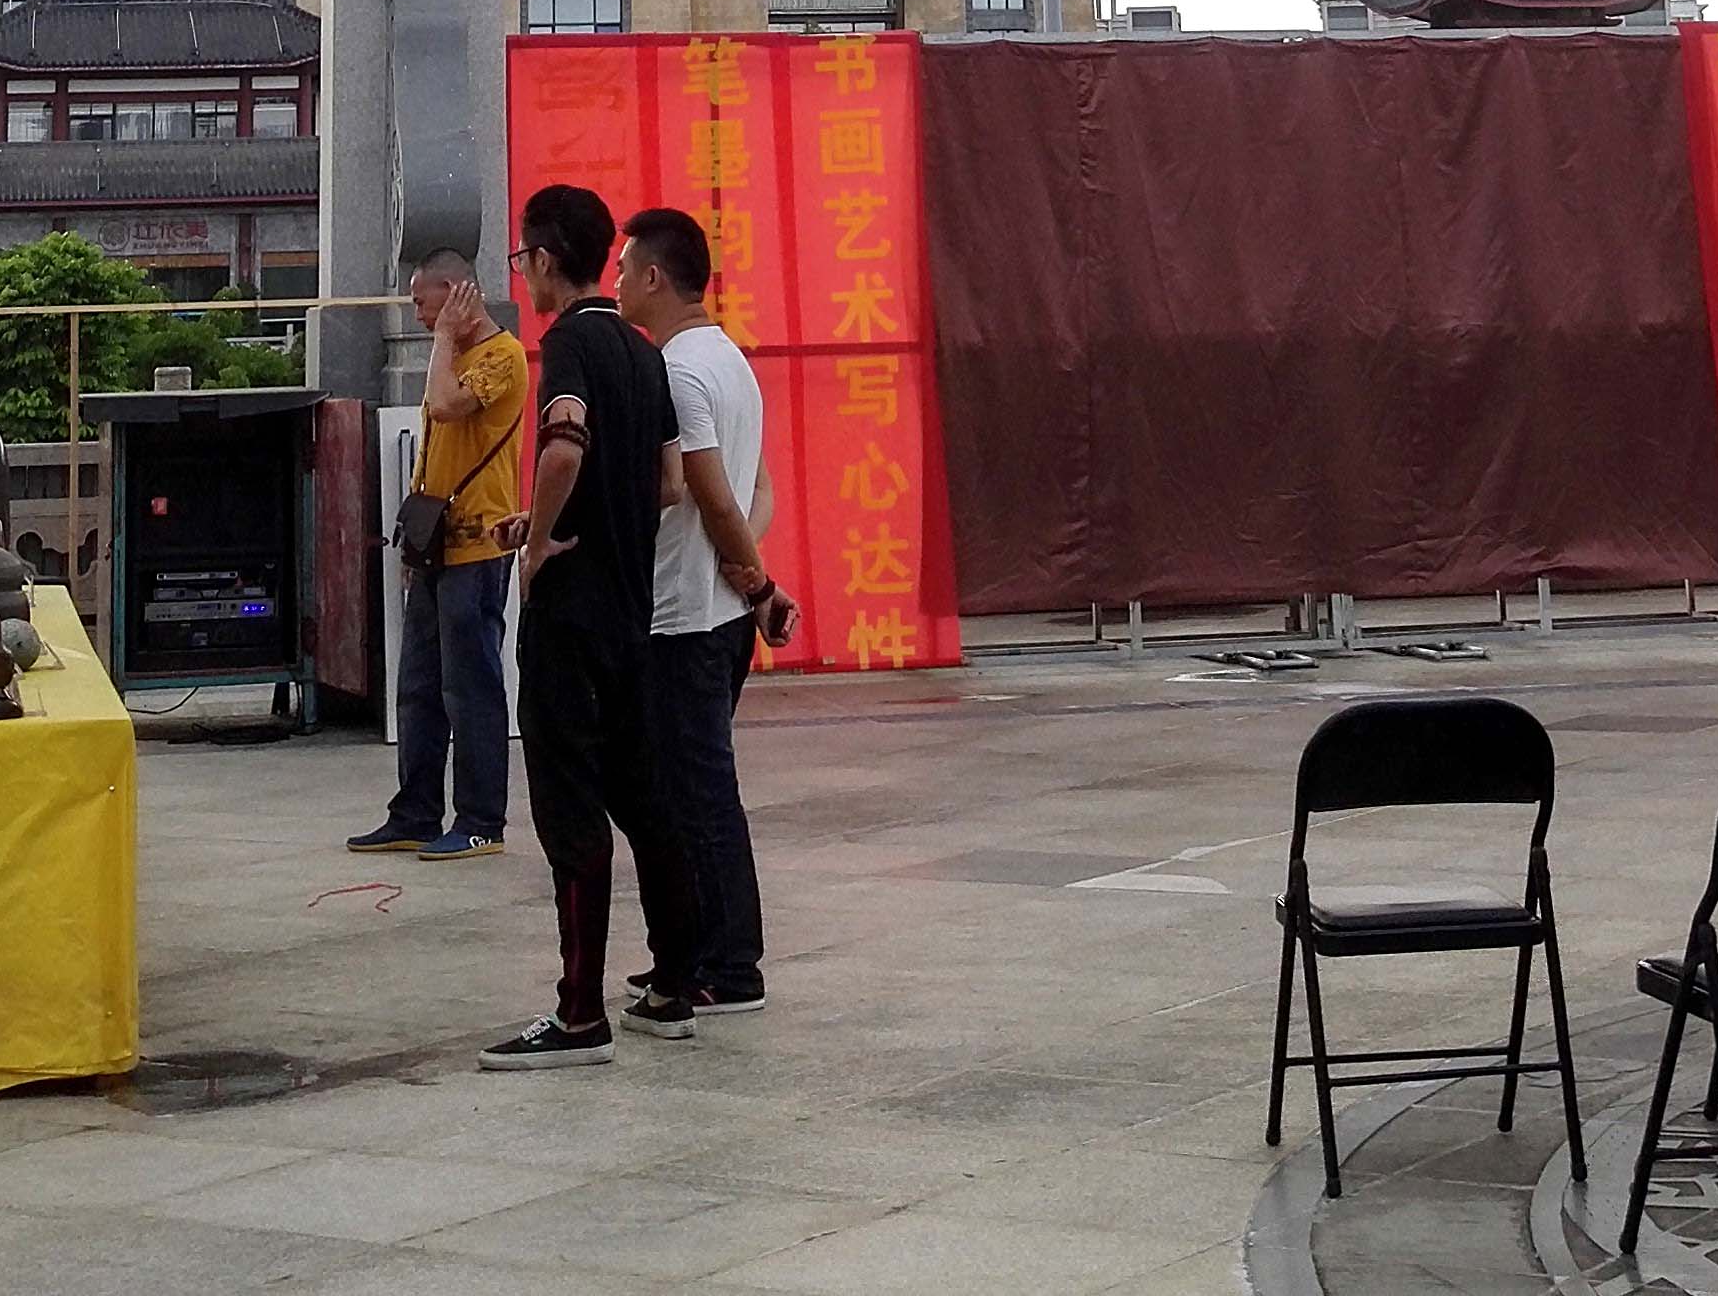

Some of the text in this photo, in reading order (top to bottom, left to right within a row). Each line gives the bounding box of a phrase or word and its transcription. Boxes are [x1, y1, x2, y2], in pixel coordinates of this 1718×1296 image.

[815, 34, 917, 670] 书画艺术写心达性
